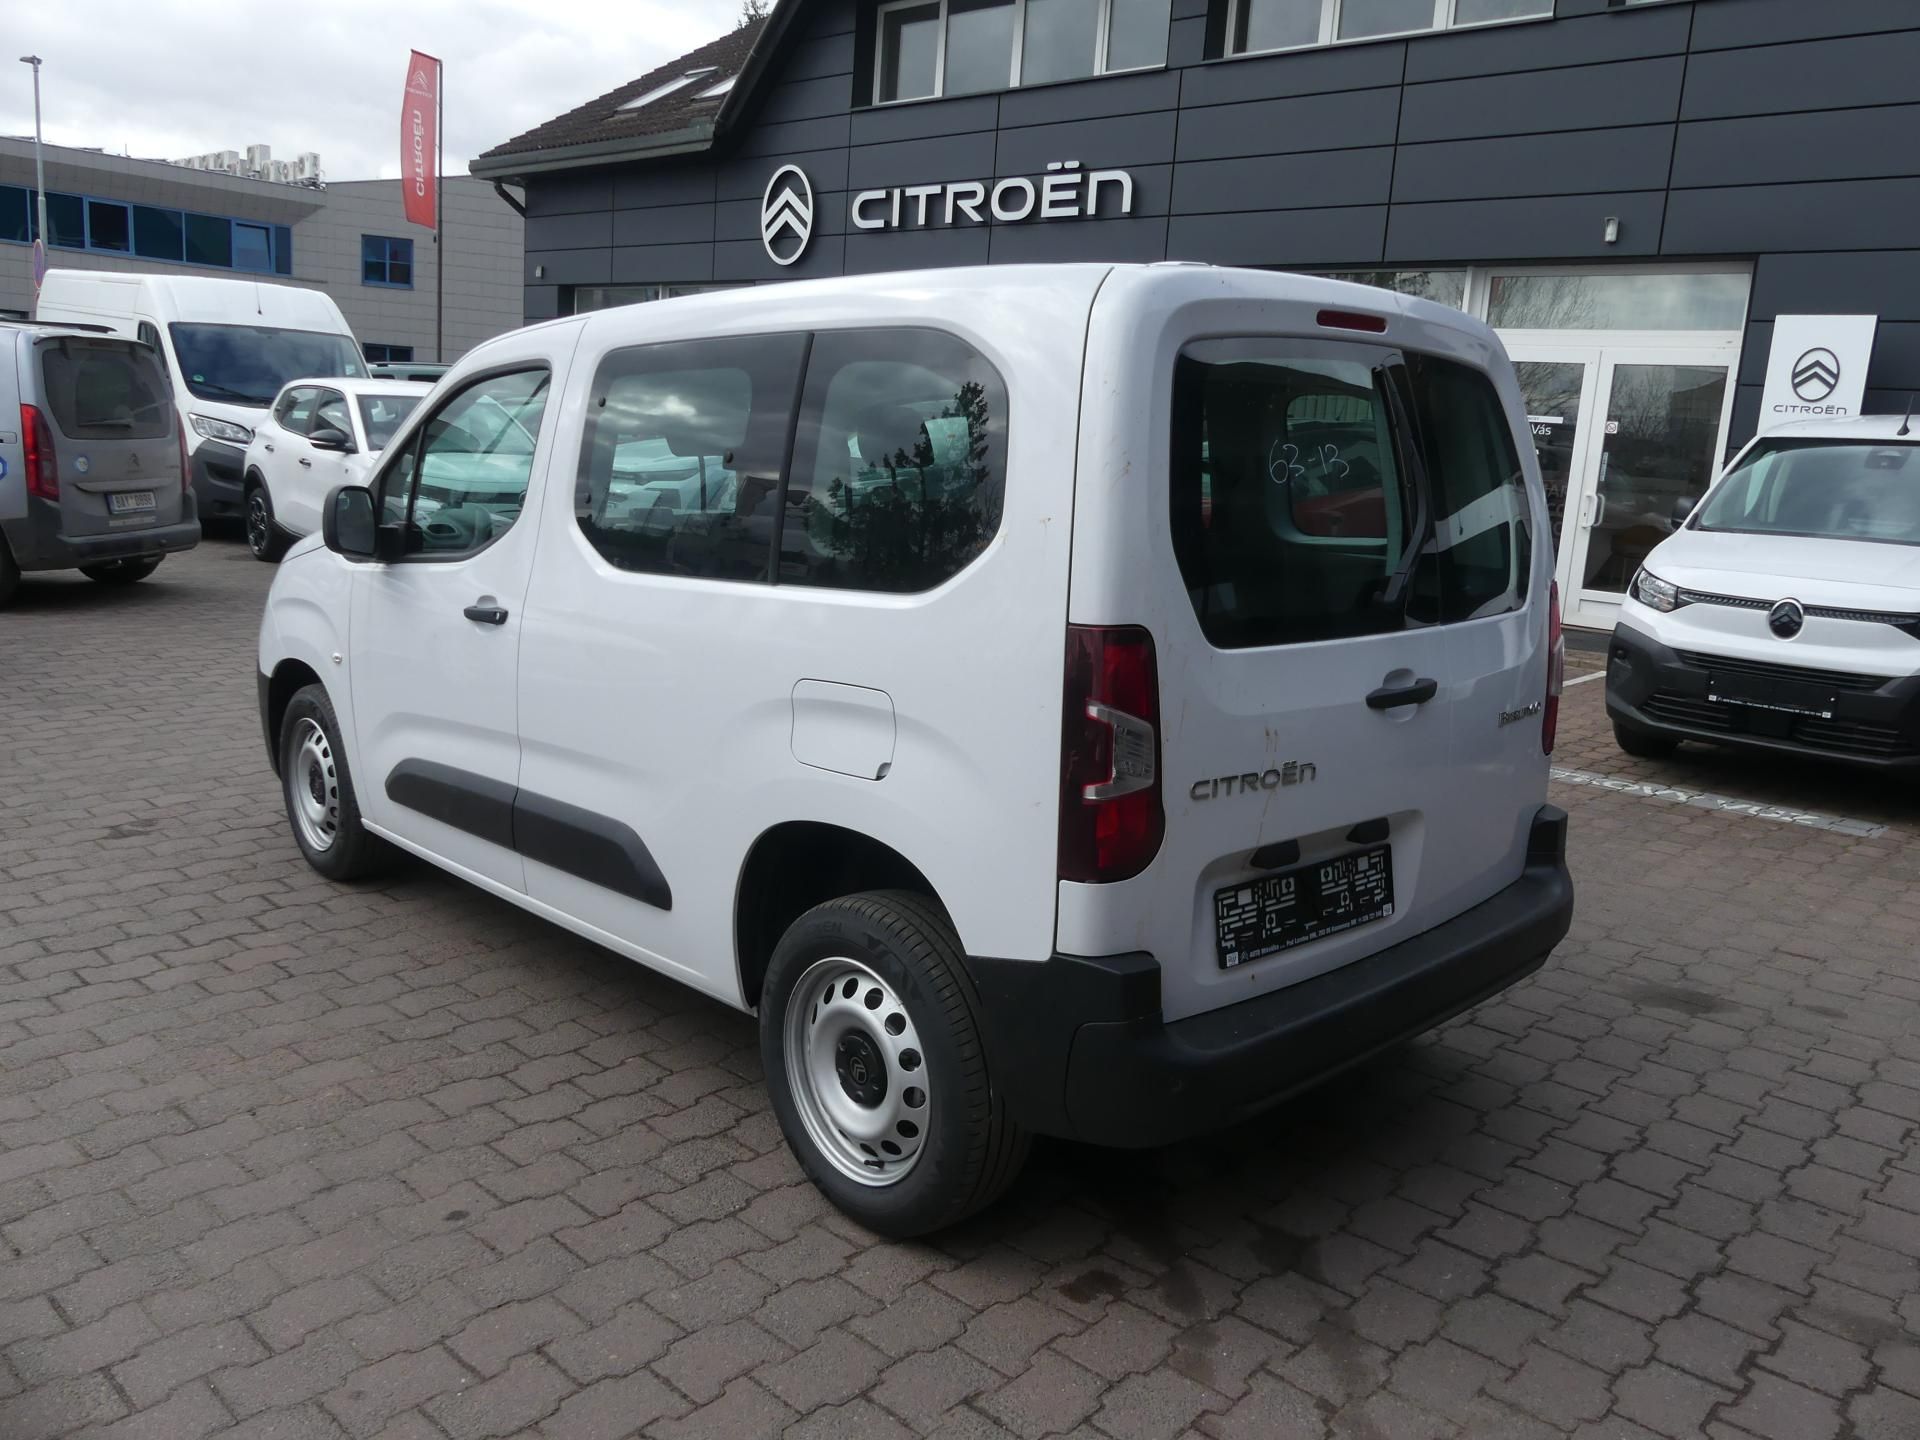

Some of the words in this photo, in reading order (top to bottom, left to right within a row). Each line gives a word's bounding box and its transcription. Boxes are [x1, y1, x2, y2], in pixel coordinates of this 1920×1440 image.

[852, 160, 1133, 229] CITROËN
[1773, 404, 1848, 415] CITROËN
[1190, 760, 1317, 801] CITROËN
